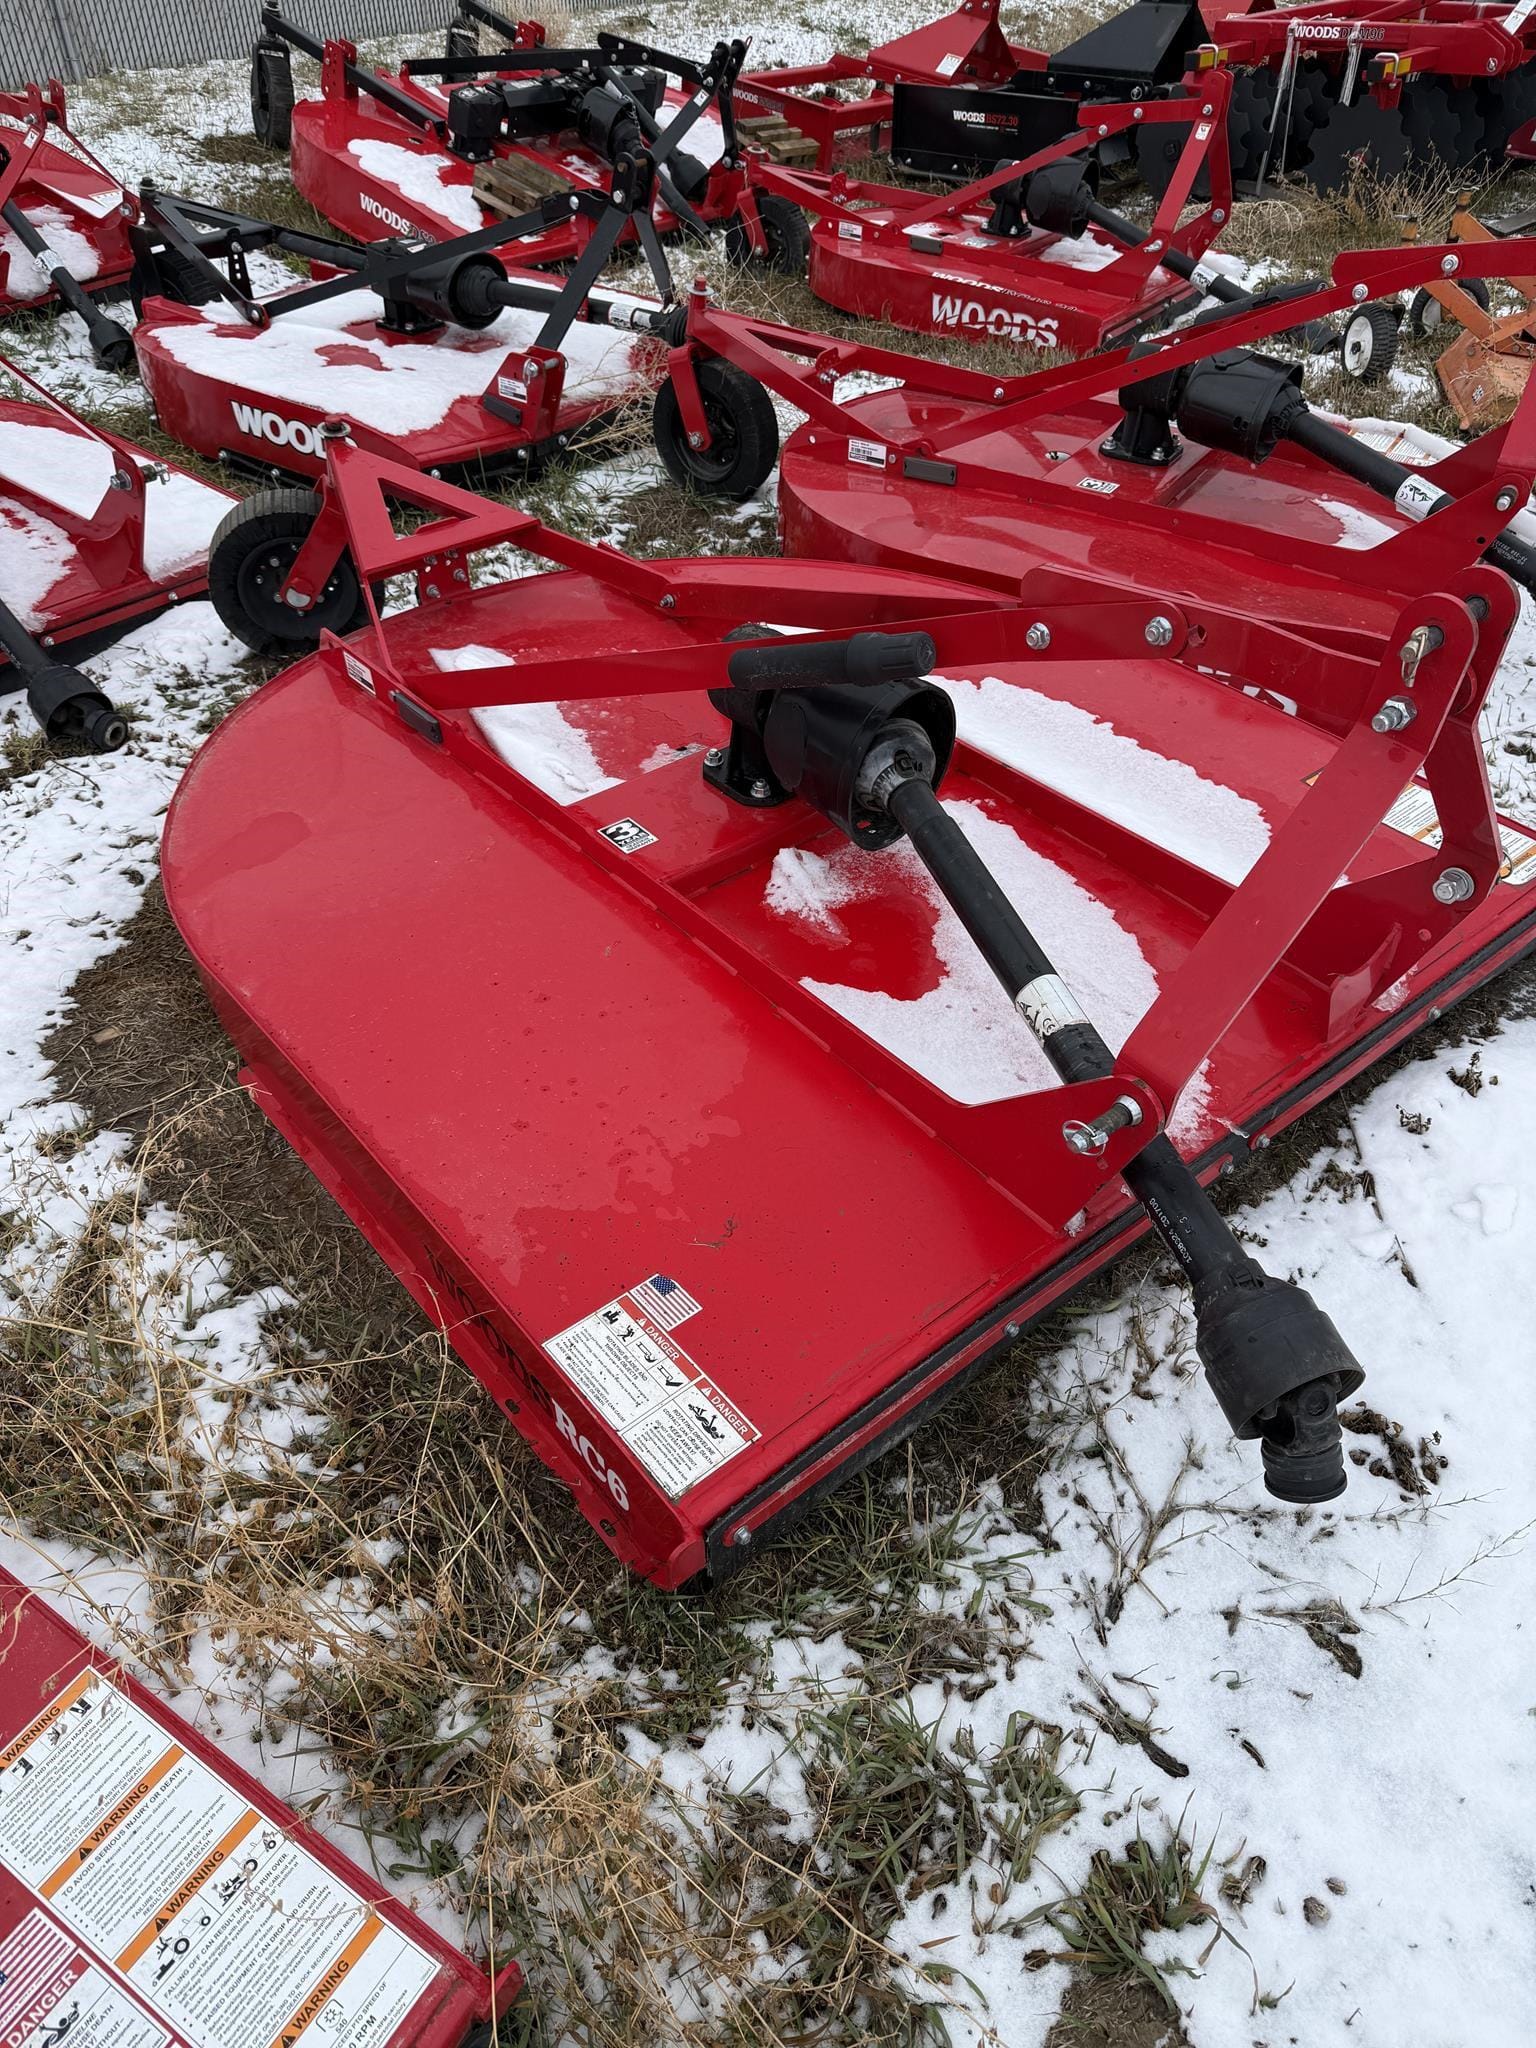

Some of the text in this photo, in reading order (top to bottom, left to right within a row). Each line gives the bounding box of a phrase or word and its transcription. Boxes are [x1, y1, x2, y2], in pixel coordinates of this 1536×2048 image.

[1295, 26, 1385, 41] WOODS DM96
[732, 88, 758, 104] WOODS
[953, 110, 985, 123] WOODS
[359, 192, 411, 236] WOODS
[932, 292, 1059, 348] WOODS
[644, 1325, 680, 1360] DANGER
[662, 1407, 714, 1465] CONTACT CAN CAUSE DEATH
[671, 1408, 715, 1456] ROTATING DRIVELINE
[710, 1395, 749, 1434] DANGER
[552, 1397, 630, 1512] RC6
[1, 1704, 61, 1764] WARNING
[5, 1718, 93, 1808] CRUSHING AND PINCHING HAZARD
[41, 1843, 62, 1866] FAILURE
[61, 1835, 70, 1844] TO
[68, 1814, 90, 1837] FOLLOW
[102, 1764, 136, 1800] INSTRUCTIONS
[134, 1748, 152, 1766] COULD
[59, 1834, 79, 1854] RESULT
[77, 1827, 85, 1835] IN
[83, 1806, 105, 1829] SERIOUS
[103, 1789, 121, 1808] INJURY
[60, 1884, 74, 1898] TO
[71, 1861, 96, 1886] AVOID
[93, 1828, 126, 1863] SERIOUS
[123, 1802, 150, 1830] INJURY
[158, 1765, 184, 1792] DEATH:
[90, 1781, 149, 1844] WARNING
[131, 1827, 213, 1920] FAILURE TO OPERATE SAFELY CAN
[142, 1893, 163, 1917] RESULT
[162, 1886, 170, 1894] IN
[167, 1867, 187, 1888] INJURY
[165, 1849, 225, 1915] WARNING
[162, 1968, 190, 1999] FALLING
[187, 1954, 202, 1970] OFF
[199, 1938, 215, 1955] CAN
[212, 1912, 236, 1940] RESULT
[234, 1904, 243, 1914] IN
[258, 1870, 273, 1886] RUN
[270, 1850, 289, 1872] OVER.
[201, 1883, 318, 2025] RAISED EQUIPMENT CAN DROP AND CRUSH.
[6, 1968, 79, 2048] DANGER
[251, 2031, 262, 2045] OFF
[269, 1998, 289, 2022] FAILING
[287, 1988, 296, 1999] TO
[294, 1969, 311, 1990] BLOCK
[310, 1940, 334, 1970] SECURELY
[332, 1927, 344, 1941] CAN
[292, 1958, 349, 2031] WARNING
[350, 2013, 364, 2029] PTO
[361, 1990, 380, 2014] SPEED
[377, 1981, 387, 1992] OF
[89, 2003, 114, 2031] DEATH
[261, 2019, 280, 2041] INJURY
[334, 2017, 348, 2034] 540
[354, 2014, 377, 2042] RPM
